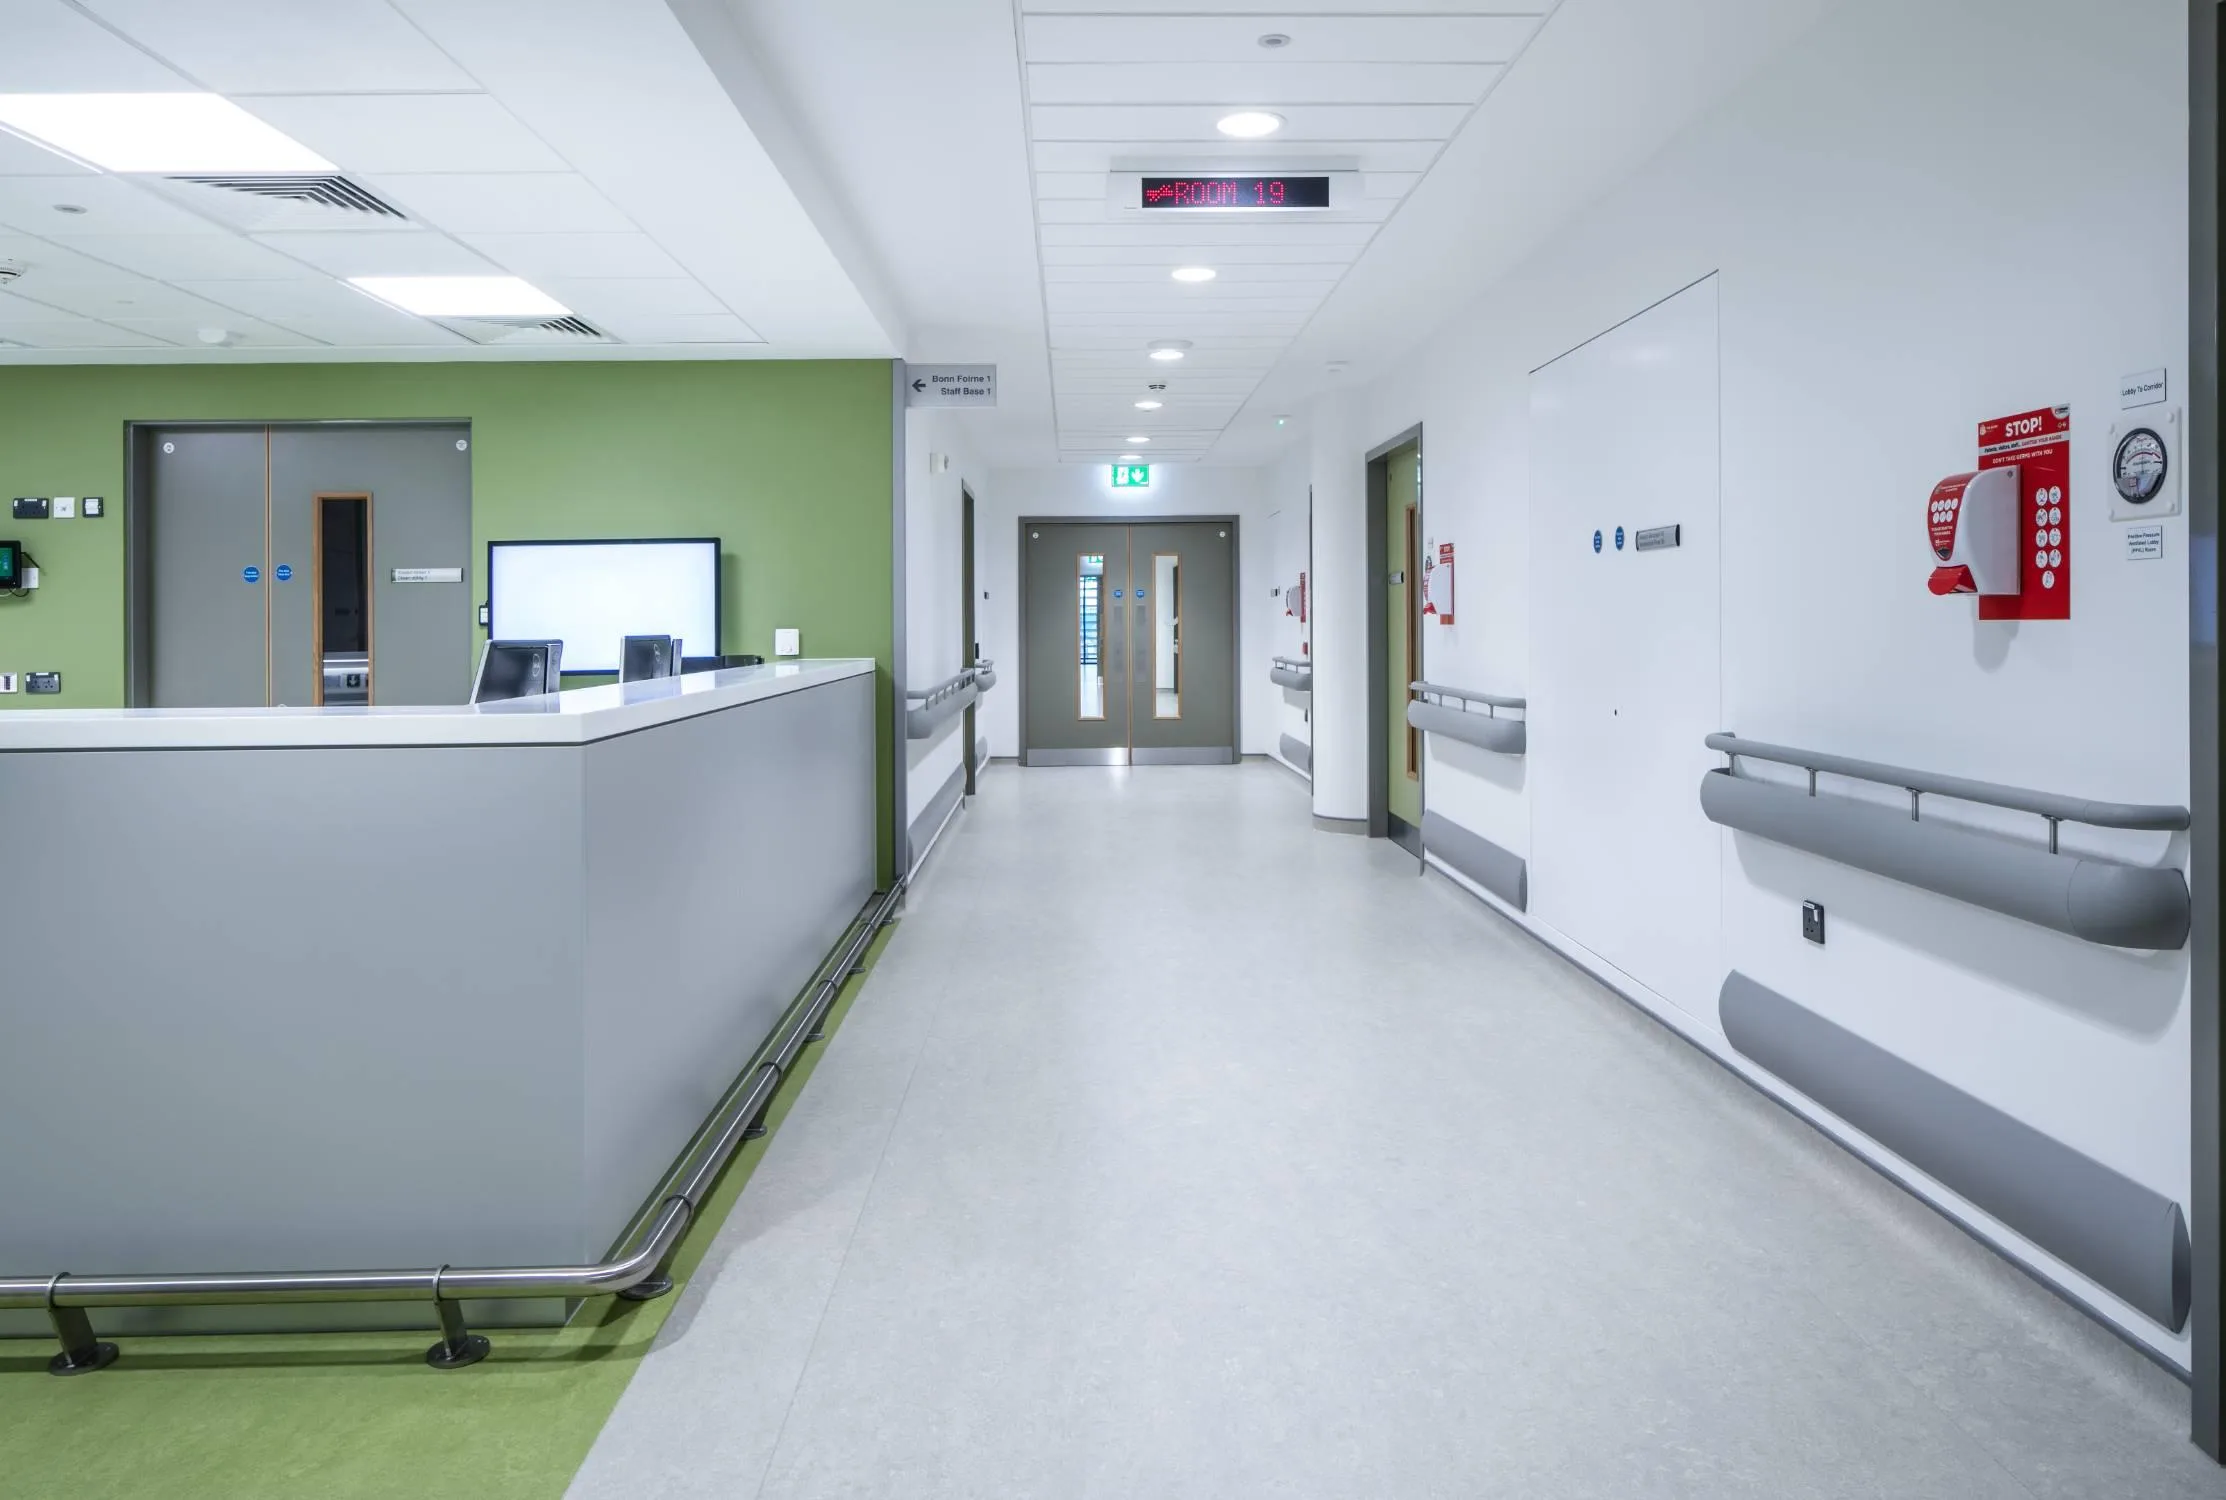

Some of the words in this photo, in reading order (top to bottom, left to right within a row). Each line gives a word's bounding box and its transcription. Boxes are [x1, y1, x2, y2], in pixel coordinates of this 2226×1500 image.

[1175, 181, 1237, 204] ROOM
[1254, 181, 1284, 204] 19
[932, 375, 955, 383] Bonn
[957, 375, 985, 383] Foirne
[986, 375, 991, 383] 1
[941, 387, 961, 396] Staff
[963, 387, 984, 396] Base
[986, 387, 991, 396] 1
[2122, 388, 2137, 397] Lobby
[2143, 382, 2163, 392] Corridor
[2005, 415, 2042, 437] STOP!
[1992, 456, 2005, 464] DON'T
[2016, 452, 2031, 460] GERMS
[2031, 450, 2043, 458] WITH
[2043, 448, 2053, 456] YOU
